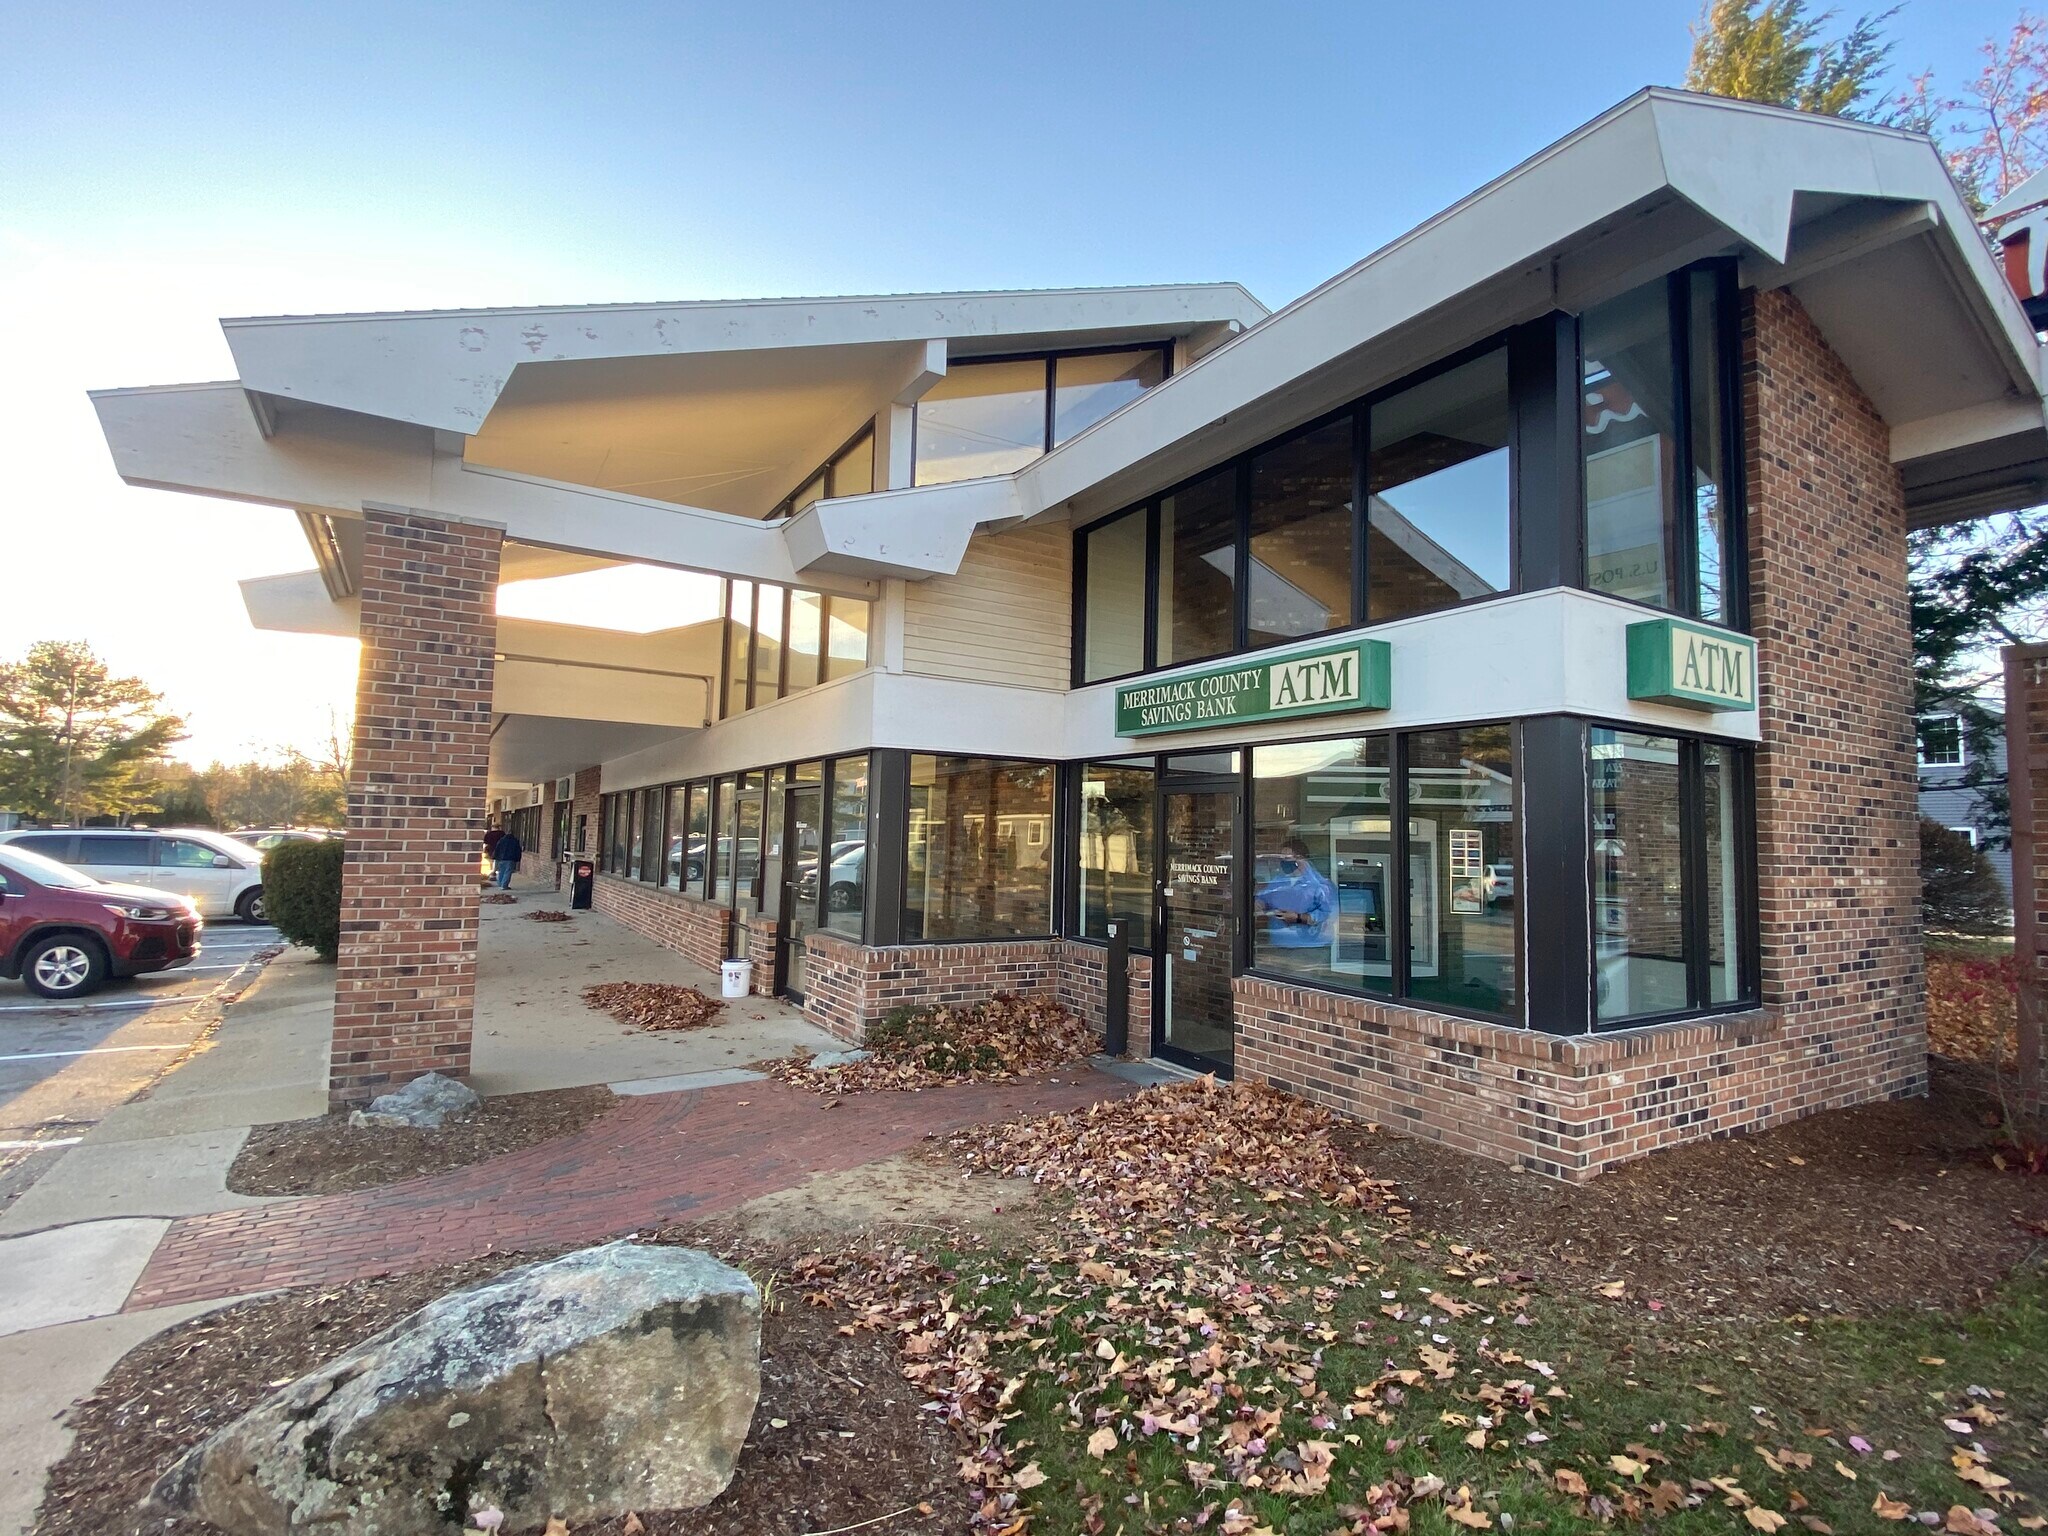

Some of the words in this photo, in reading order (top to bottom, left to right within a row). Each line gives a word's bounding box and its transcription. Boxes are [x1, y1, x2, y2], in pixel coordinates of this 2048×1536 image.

[1275, 657, 1353, 706] ATM
[1681, 635, 1743, 698] ATM
[1123, 680, 1197, 710] MERRIMACK
[1200, 668, 1264, 696] COUNTY
[1141, 701, 1192, 726] SAVINGS
[1196, 695, 1237, 719] BANK
[1170, 863, 1202, 873] MERRIMACK
[1203, 864, 1228, 874] COUNTY
[1177, 873, 1200, 884] SAVINGS
[1201, 875, 1218, 885] BANK
